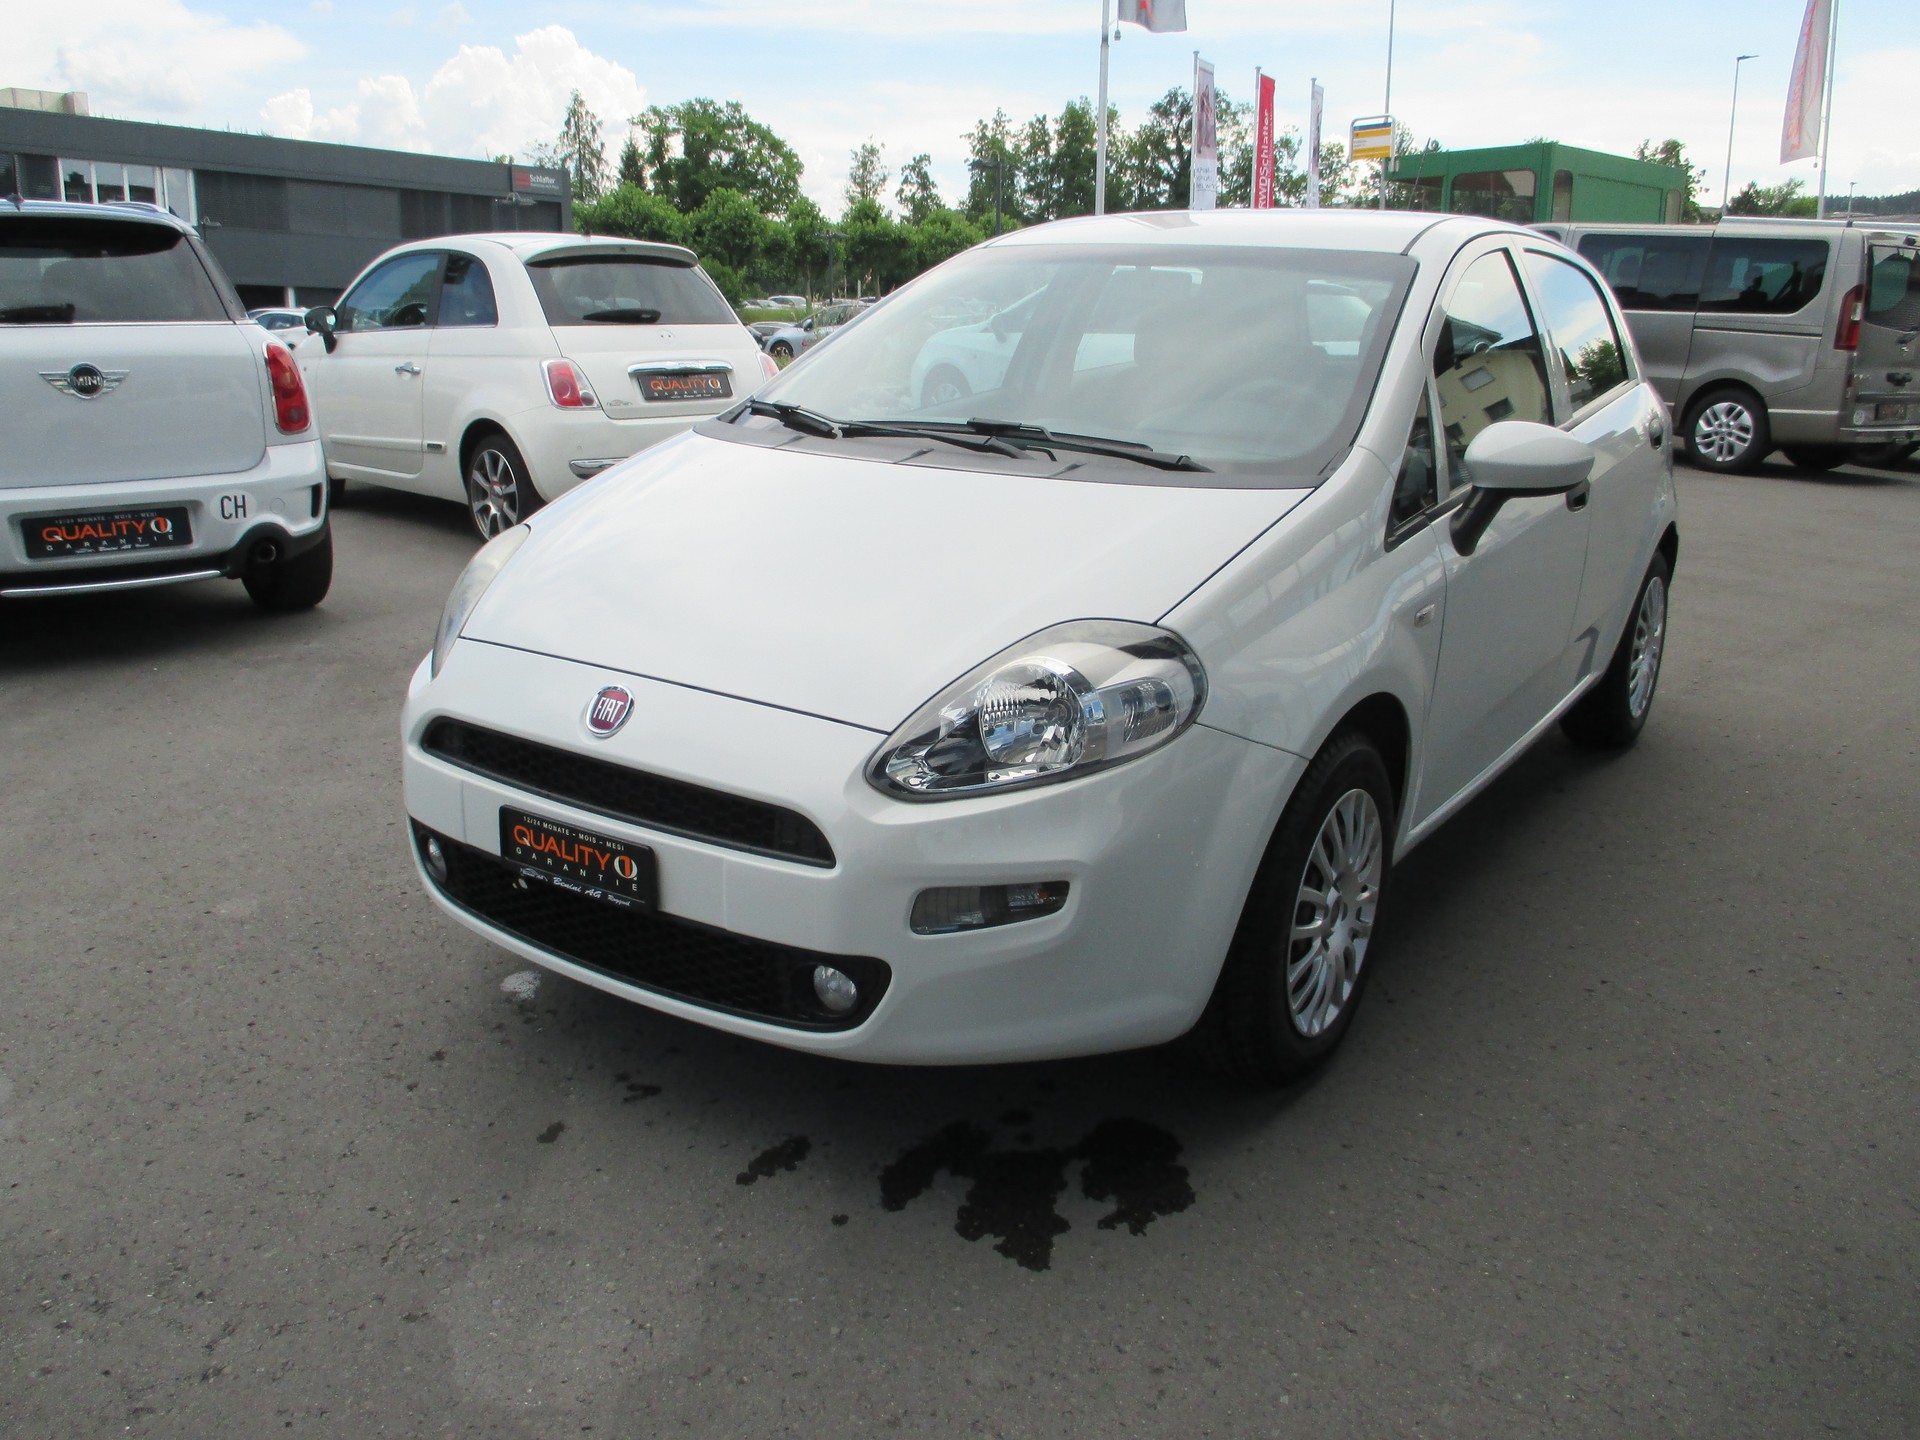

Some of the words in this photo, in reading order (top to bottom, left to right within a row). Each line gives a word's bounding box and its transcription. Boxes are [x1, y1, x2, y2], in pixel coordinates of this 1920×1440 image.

[74, 374, 101, 386] MINI
[650, 377, 706, 391] QUALITY
[220, 494, 247, 520] CH
[41, 519, 147, 542] QUALITY
[46, 534, 174, 552] GARANTIE
[593, 696, 624, 723] FIAT
[513, 825, 611, 871] QUALITY
[543, 823, 570, 836] MONATE
[578, 832, 597, 844] MOIS
[606, 841, 625, 852] MESI
[516, 846, 638, 892] GARANTIE
[584, 888, 602, 899] AG
